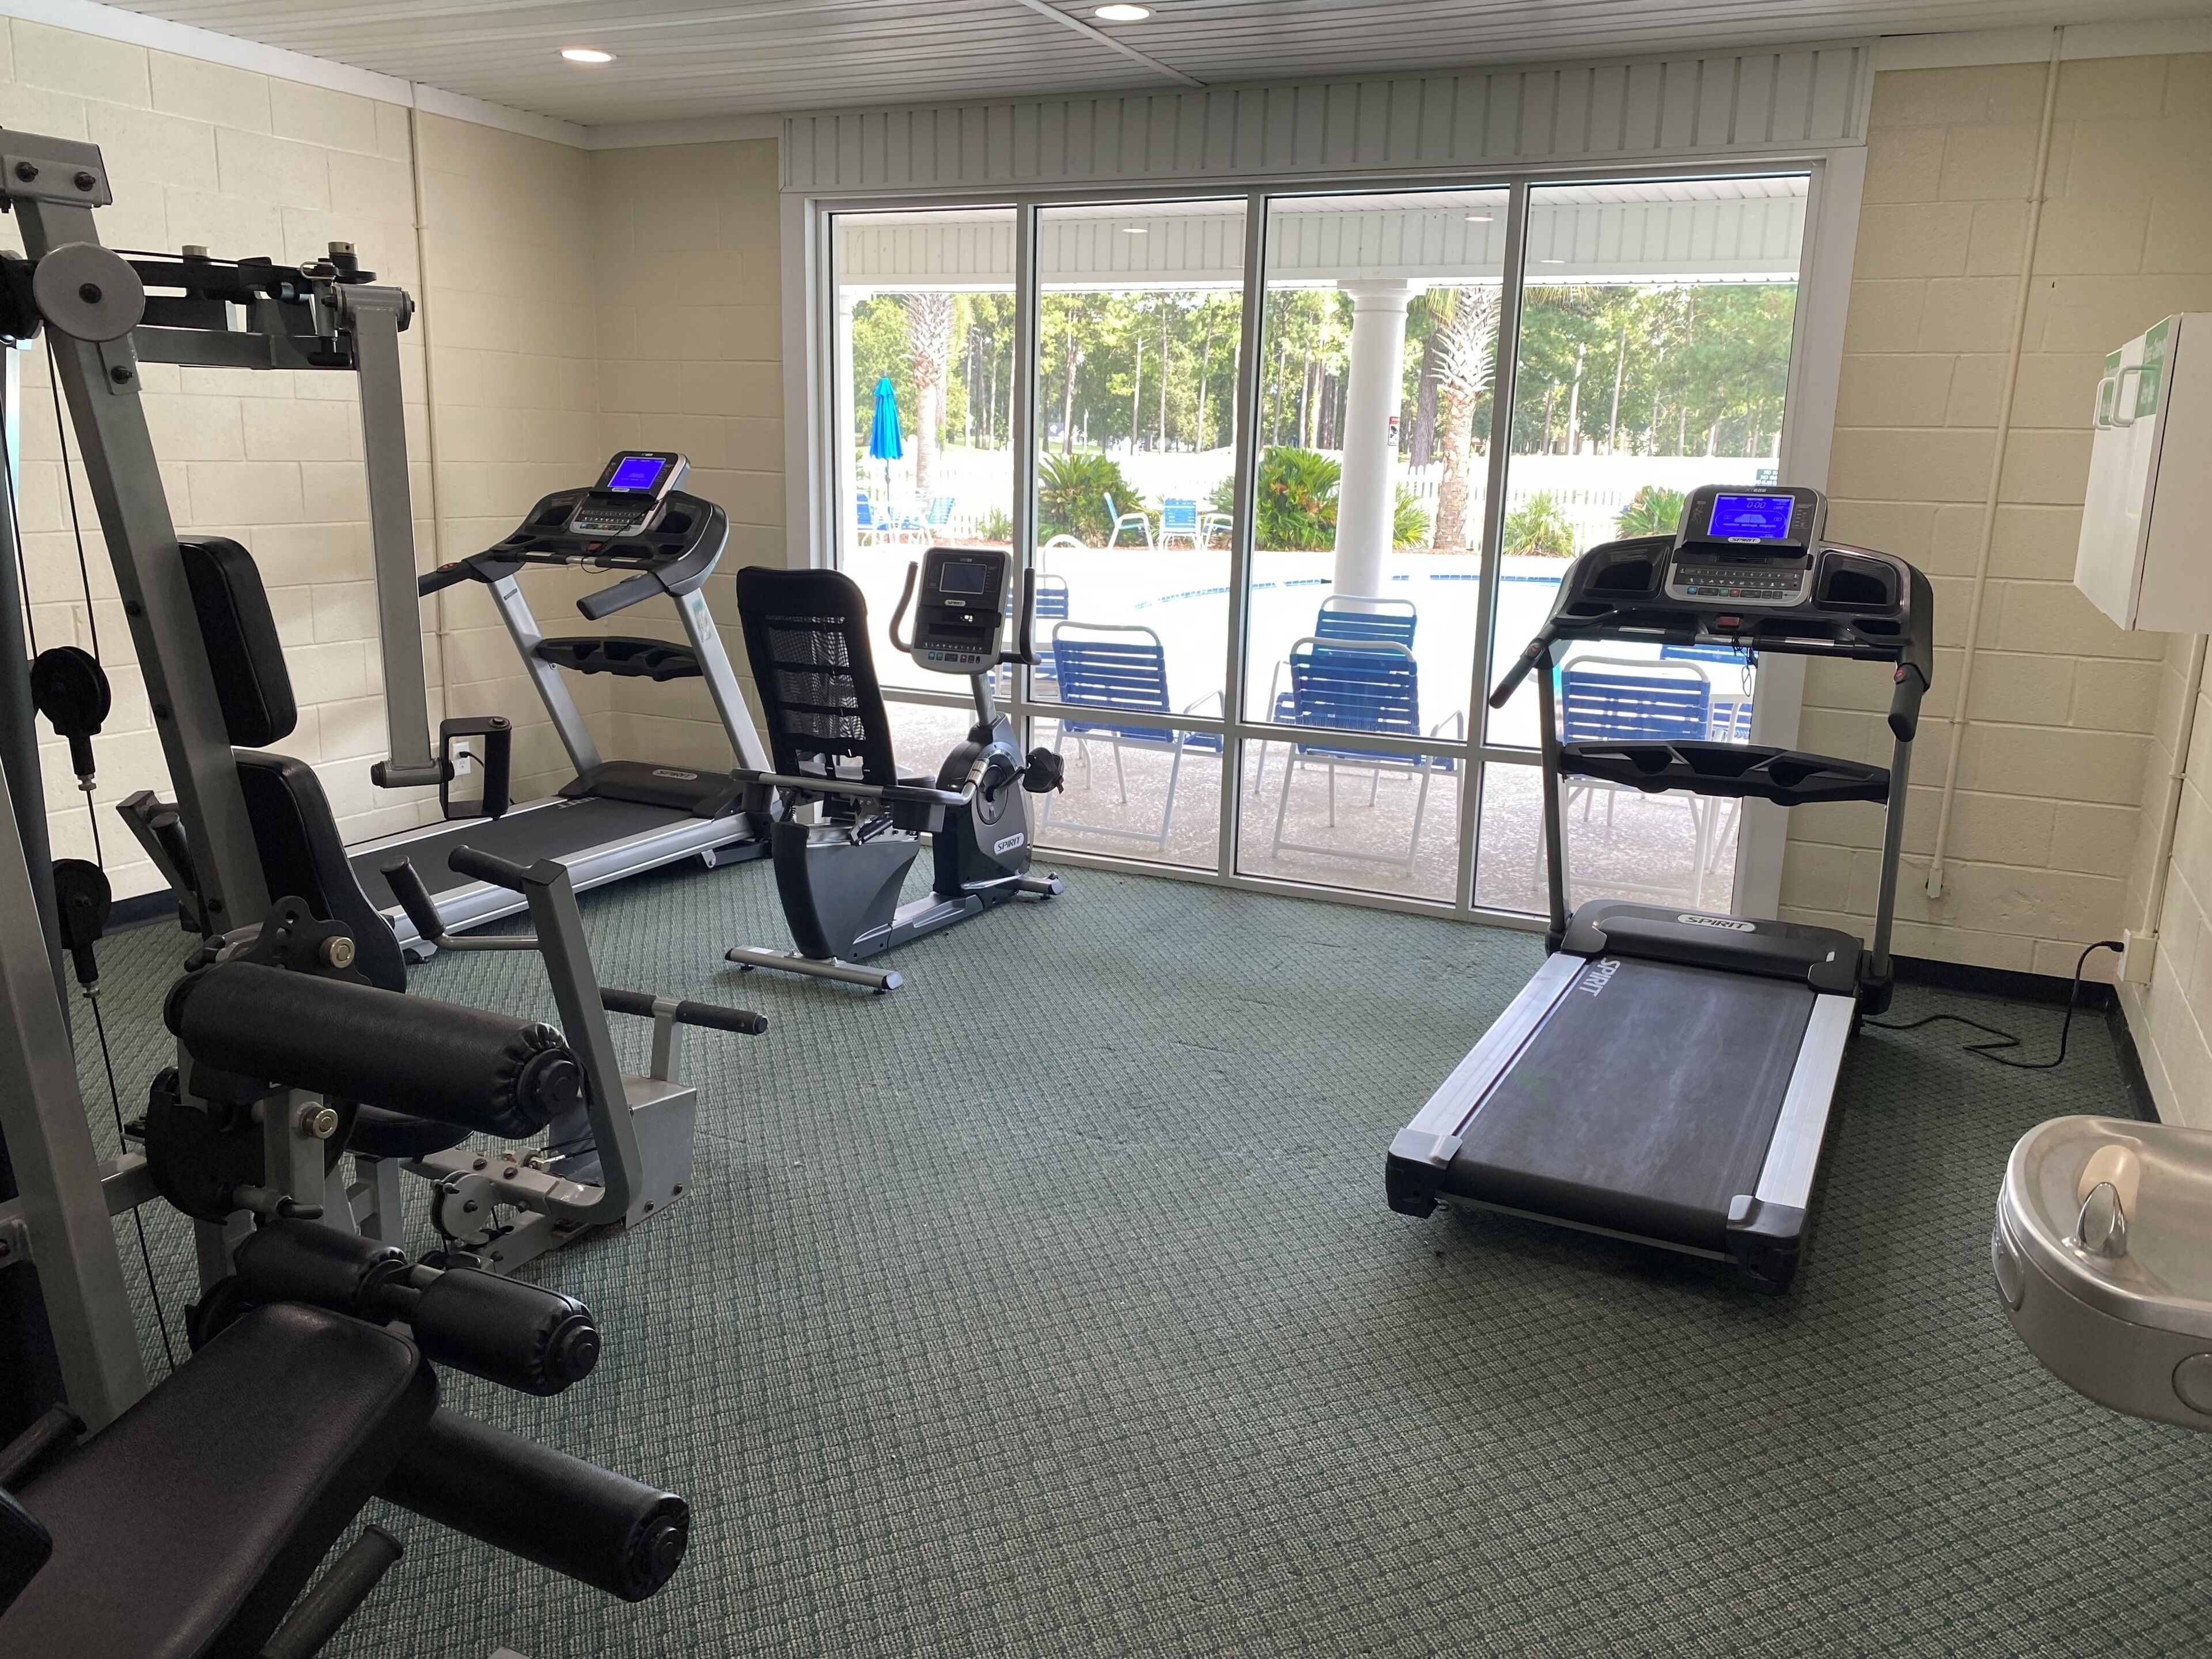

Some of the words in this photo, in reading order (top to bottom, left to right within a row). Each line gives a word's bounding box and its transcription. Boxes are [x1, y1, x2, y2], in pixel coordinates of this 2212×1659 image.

[997, 836, 1021, 852] SPIRIT
[1685, 917, 1748, 929] SPIRIT
[1579, 957, 1620, 997] SPIRIT
